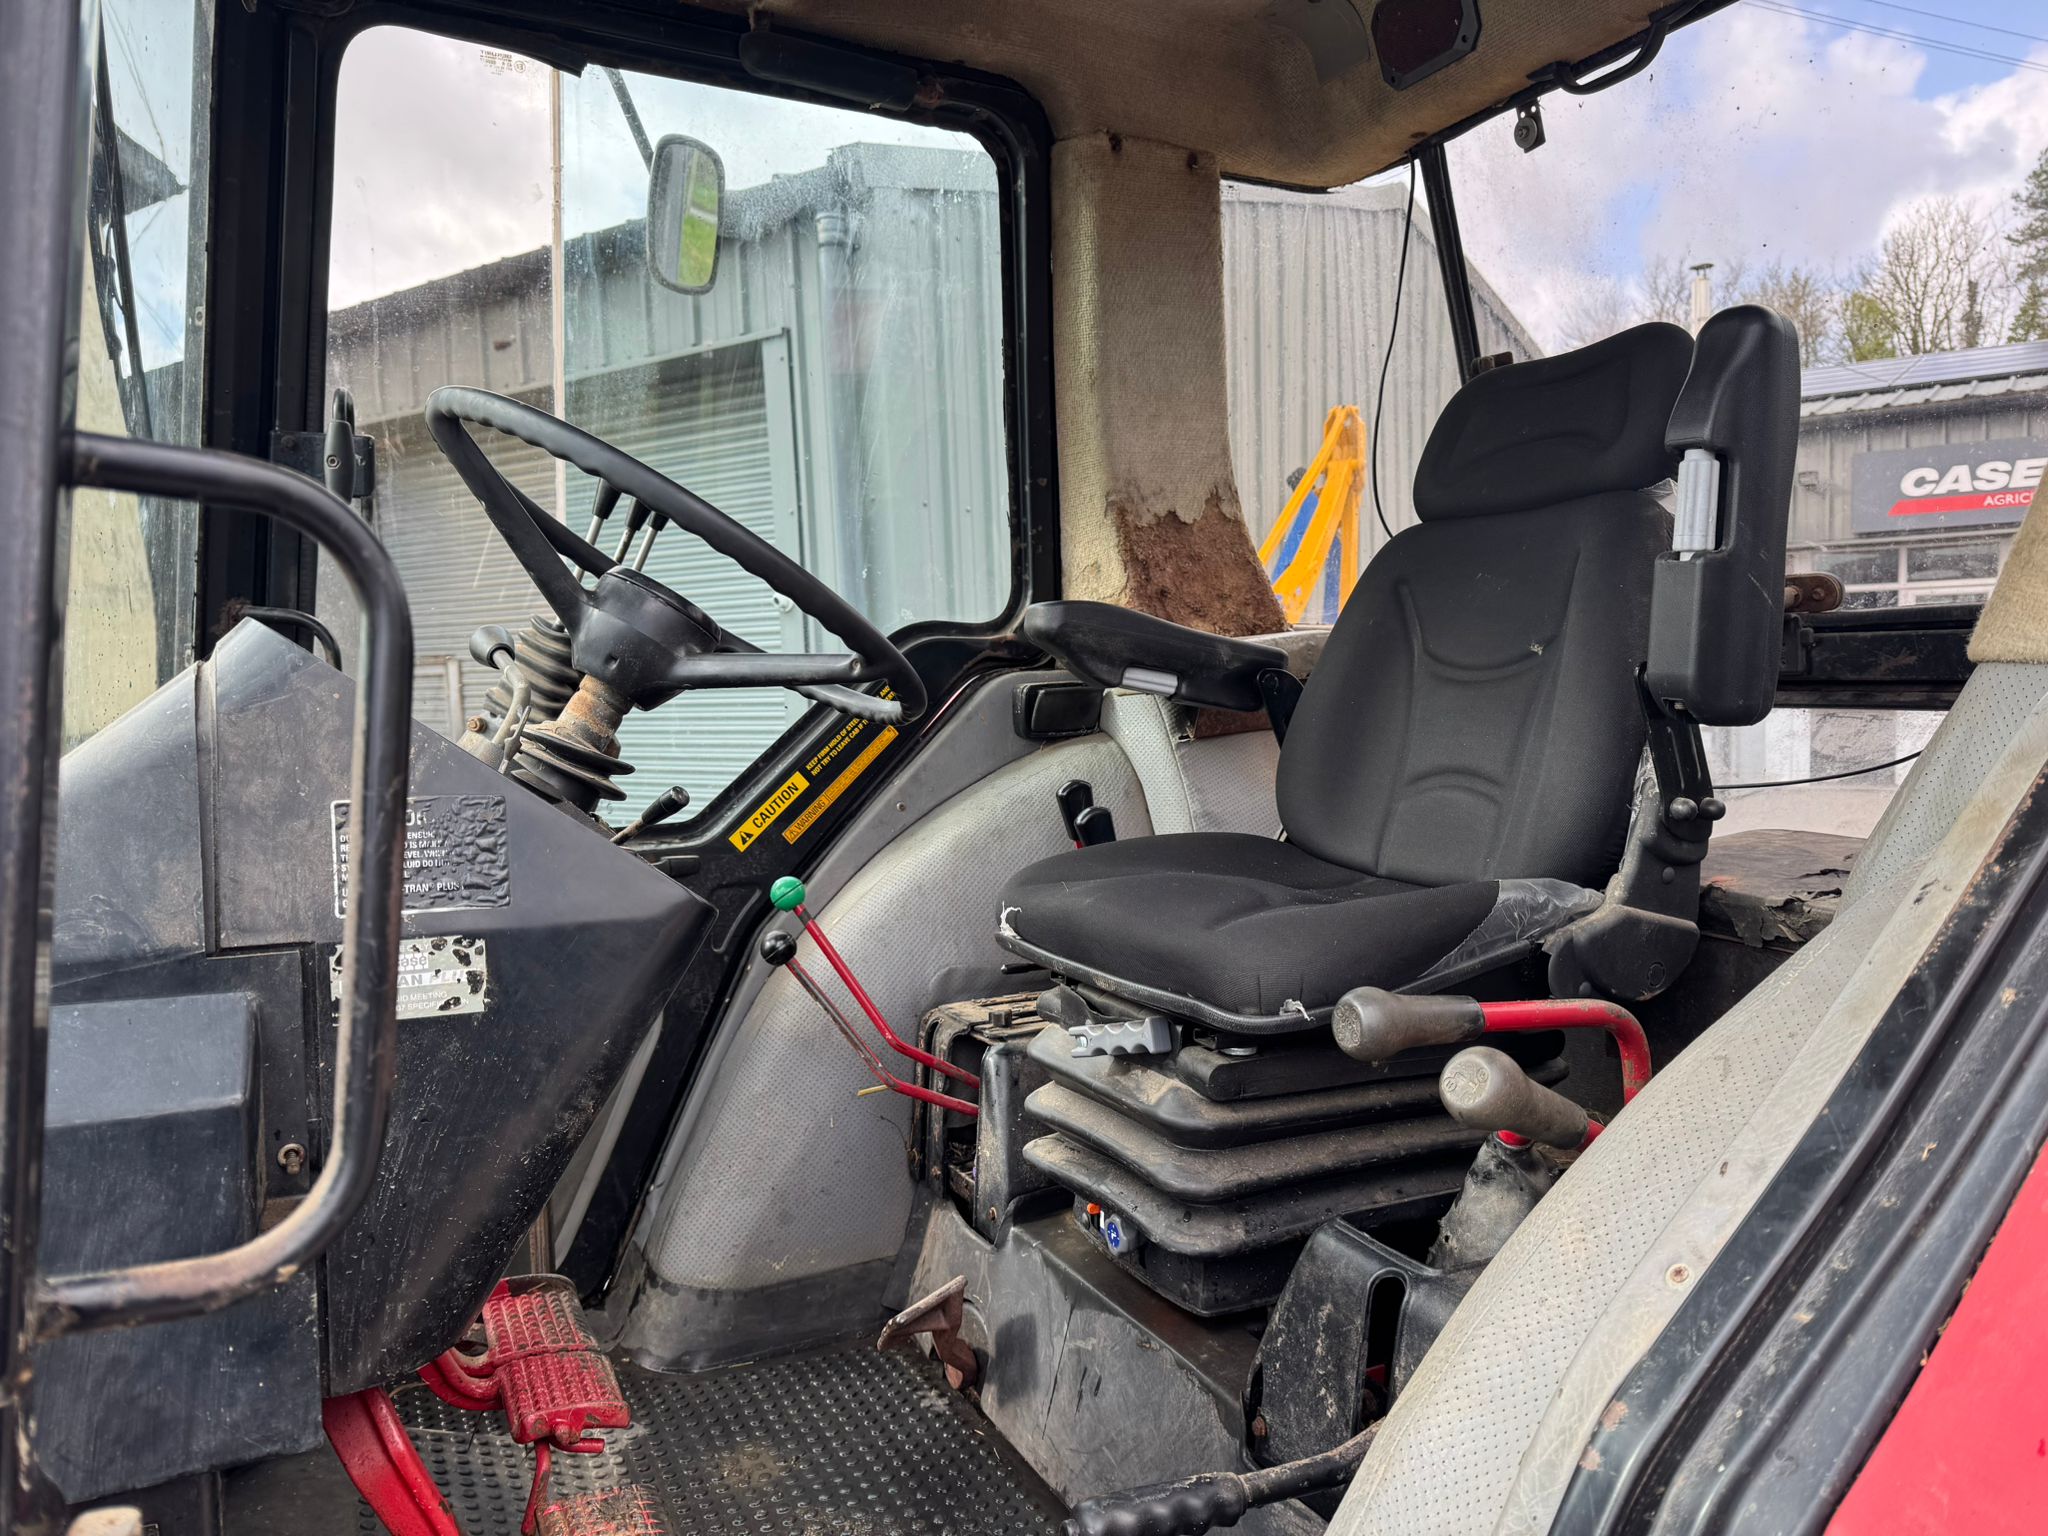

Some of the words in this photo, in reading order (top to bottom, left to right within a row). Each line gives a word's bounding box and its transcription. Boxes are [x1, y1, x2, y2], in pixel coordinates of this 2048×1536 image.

[1901, 457, 2048, 497] CASE
[811, 764, 822, 776] NOT
[752, 782, 799, 828] CAUTION
[794, 799, 826, 831] WARNING
